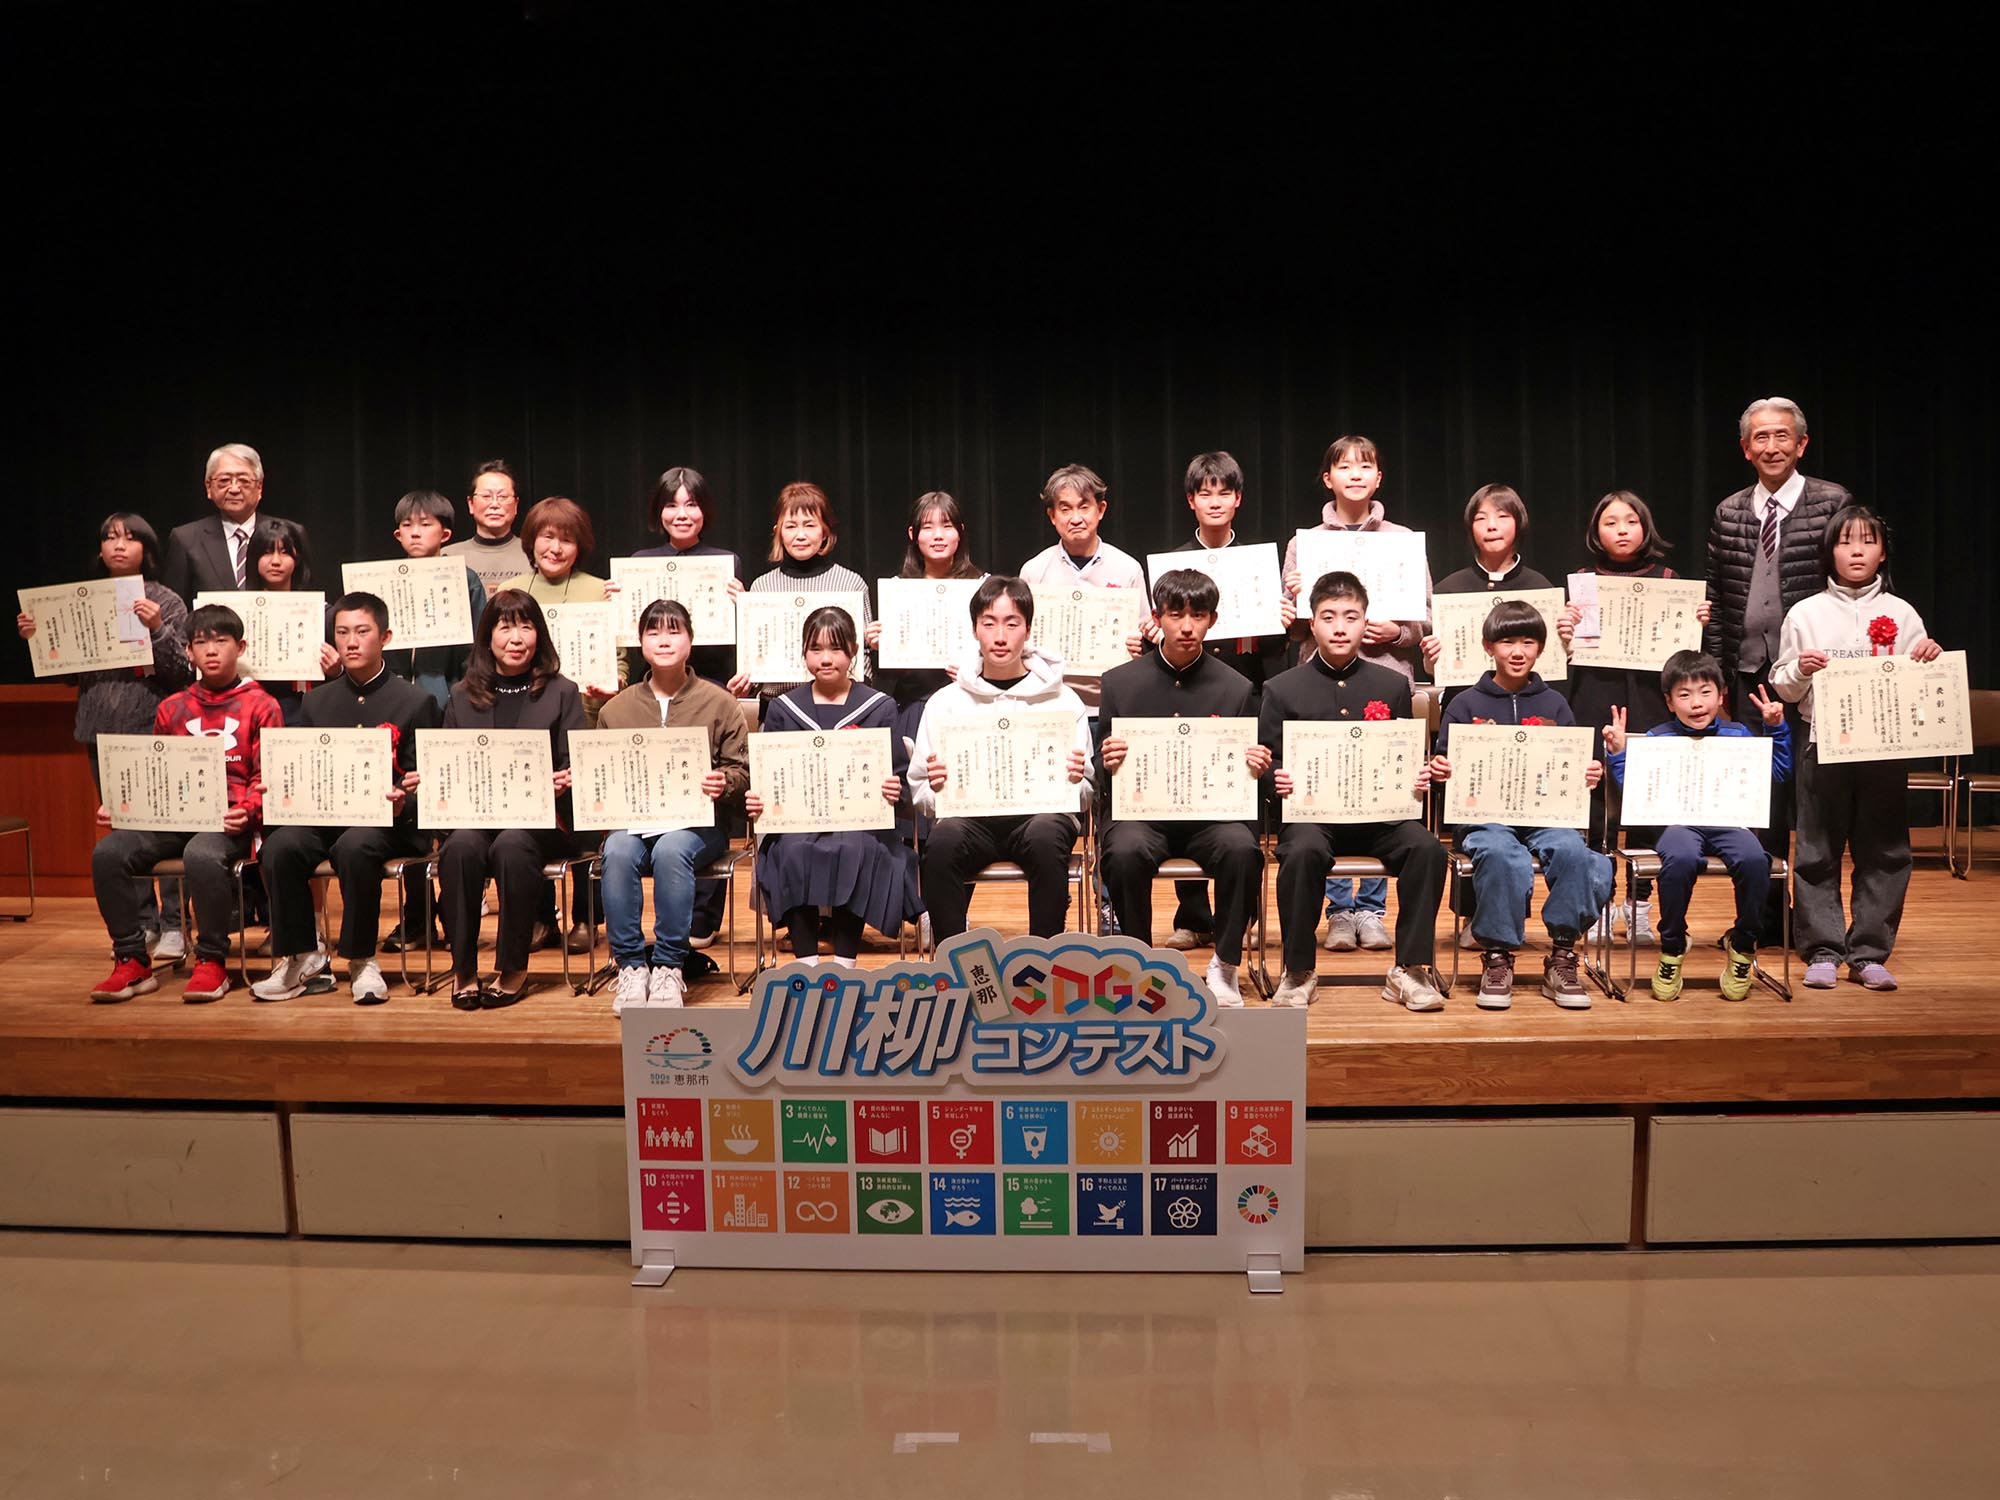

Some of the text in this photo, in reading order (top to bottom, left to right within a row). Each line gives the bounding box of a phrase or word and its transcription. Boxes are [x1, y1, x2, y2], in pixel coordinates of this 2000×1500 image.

[1226, 752, 1235, 789] 表彰状
[969, 964, 998, 1005] 恵那
[1011, 964, 1166, 1016] SDGs
[744, 984, 971, 1071] 川柳
[977, 1023, 1209, 1071] コンテスト
[674, 1074, 709, 1086] 恵那市
[640, 1102, 646, 1116] 1
[713, 1103, 721, 1117] 2
[785, 1104, 794, 1118] 3
[858, 1105, 867, 1119] 4
[932, 1105, 940, 1119] 5
[1006, 1106, 1014, 1120] 6
[1080, 1105, 1087, 1120] 7
[1154, 1106, 1163, 1120] 8
[1230, 1106, 1238, 1120] 9
[642, 1173, 657, 1187] 10
[715, 1175, 726, 1188] 11
[787, 1176, 801, 1189] 12
[860, 1176, 873, 1190] 13
[933, 1177, 947, 1191] 14
[1006, 1177, 1020, 1191] 15
[1080, 1177, 1094, 1191] 16
[1154, 1177, 1167, 1191] 17
